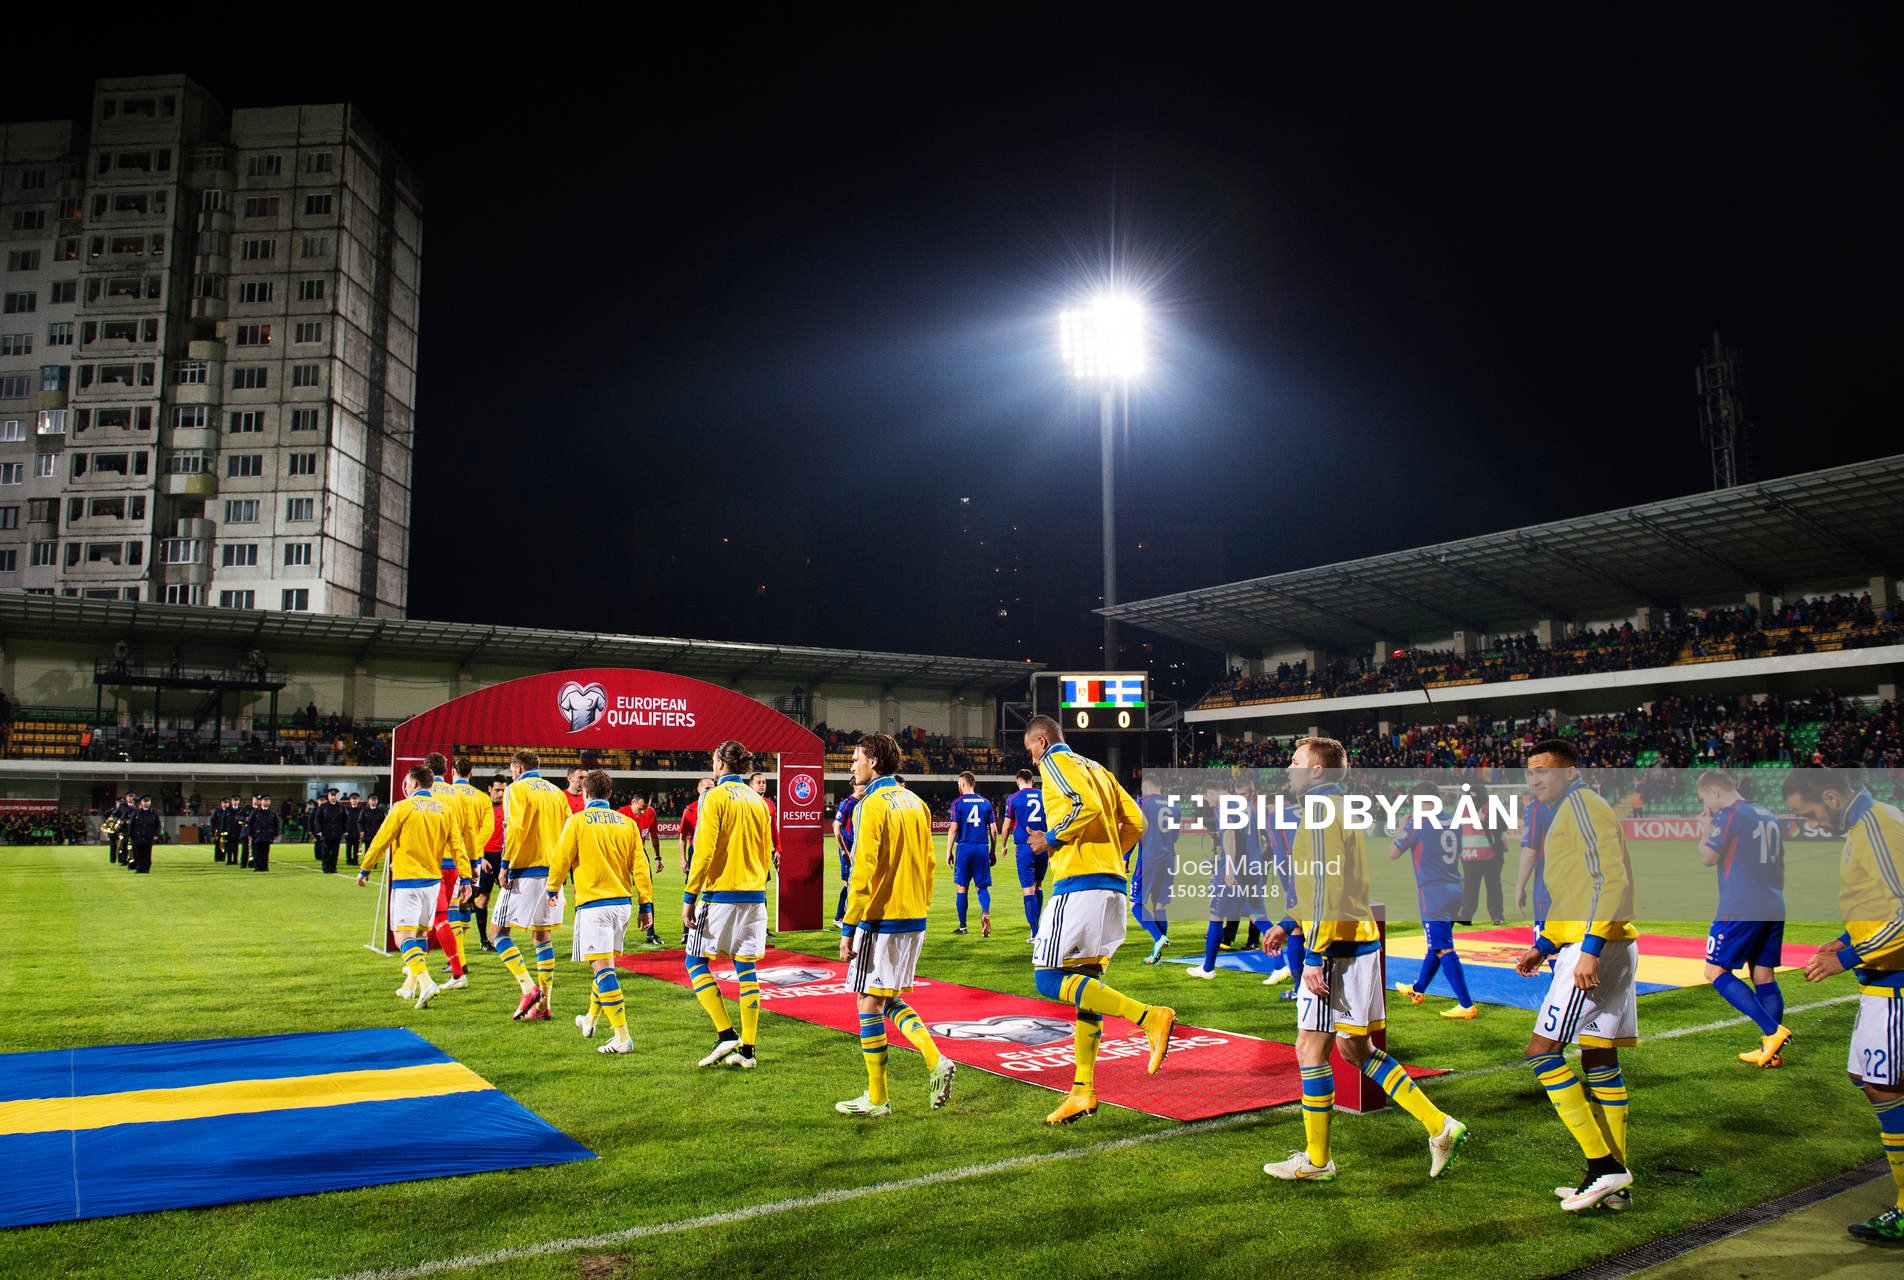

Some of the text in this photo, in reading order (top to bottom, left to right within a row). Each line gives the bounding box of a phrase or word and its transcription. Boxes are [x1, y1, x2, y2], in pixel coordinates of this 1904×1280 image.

[617, 696, 686, 711] EUROPEAN
[607, 710, 696, 727] QUALIFIERS
[1118, 711, 1131, 729] 0
[793, 775, 812, 784] UEFA
[585, 811, 626, 825] SVERIGE
[783, 811, 822, 821] RESPECT
[966, 804, 981, 827] 4
[1026, 799, 1042, 822] 2
[1441, 830, 1458, 865] 9
[1753, 820, 1781, 864] 10
[1302, 997, 1313, 1022] 7
[1544, 1004, 1560, 1032] 5
[1863, 1048, 1888, 1079] 22
